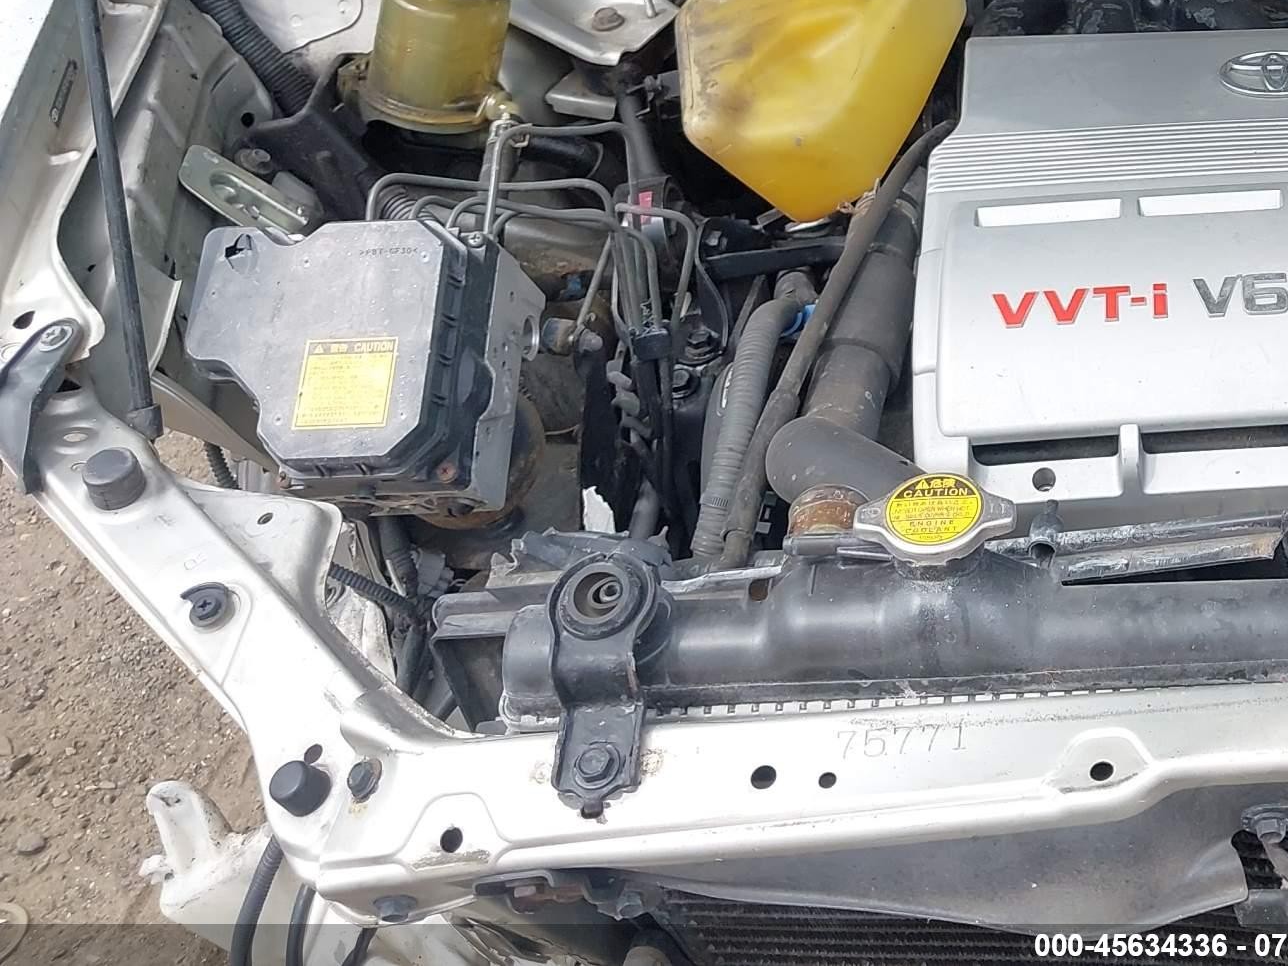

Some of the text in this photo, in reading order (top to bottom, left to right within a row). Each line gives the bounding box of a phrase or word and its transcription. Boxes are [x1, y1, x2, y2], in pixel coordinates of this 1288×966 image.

[992, 282, 1169, 329] VVT-i
[353, 340, 394, 353] CAUTION
[903, 488, 968, 498] CAUTION
[909, 519, 955, 527] ENGINE
[905, 525, 958, 534] COOLANT
[837, 718, 967, 759] 75771
